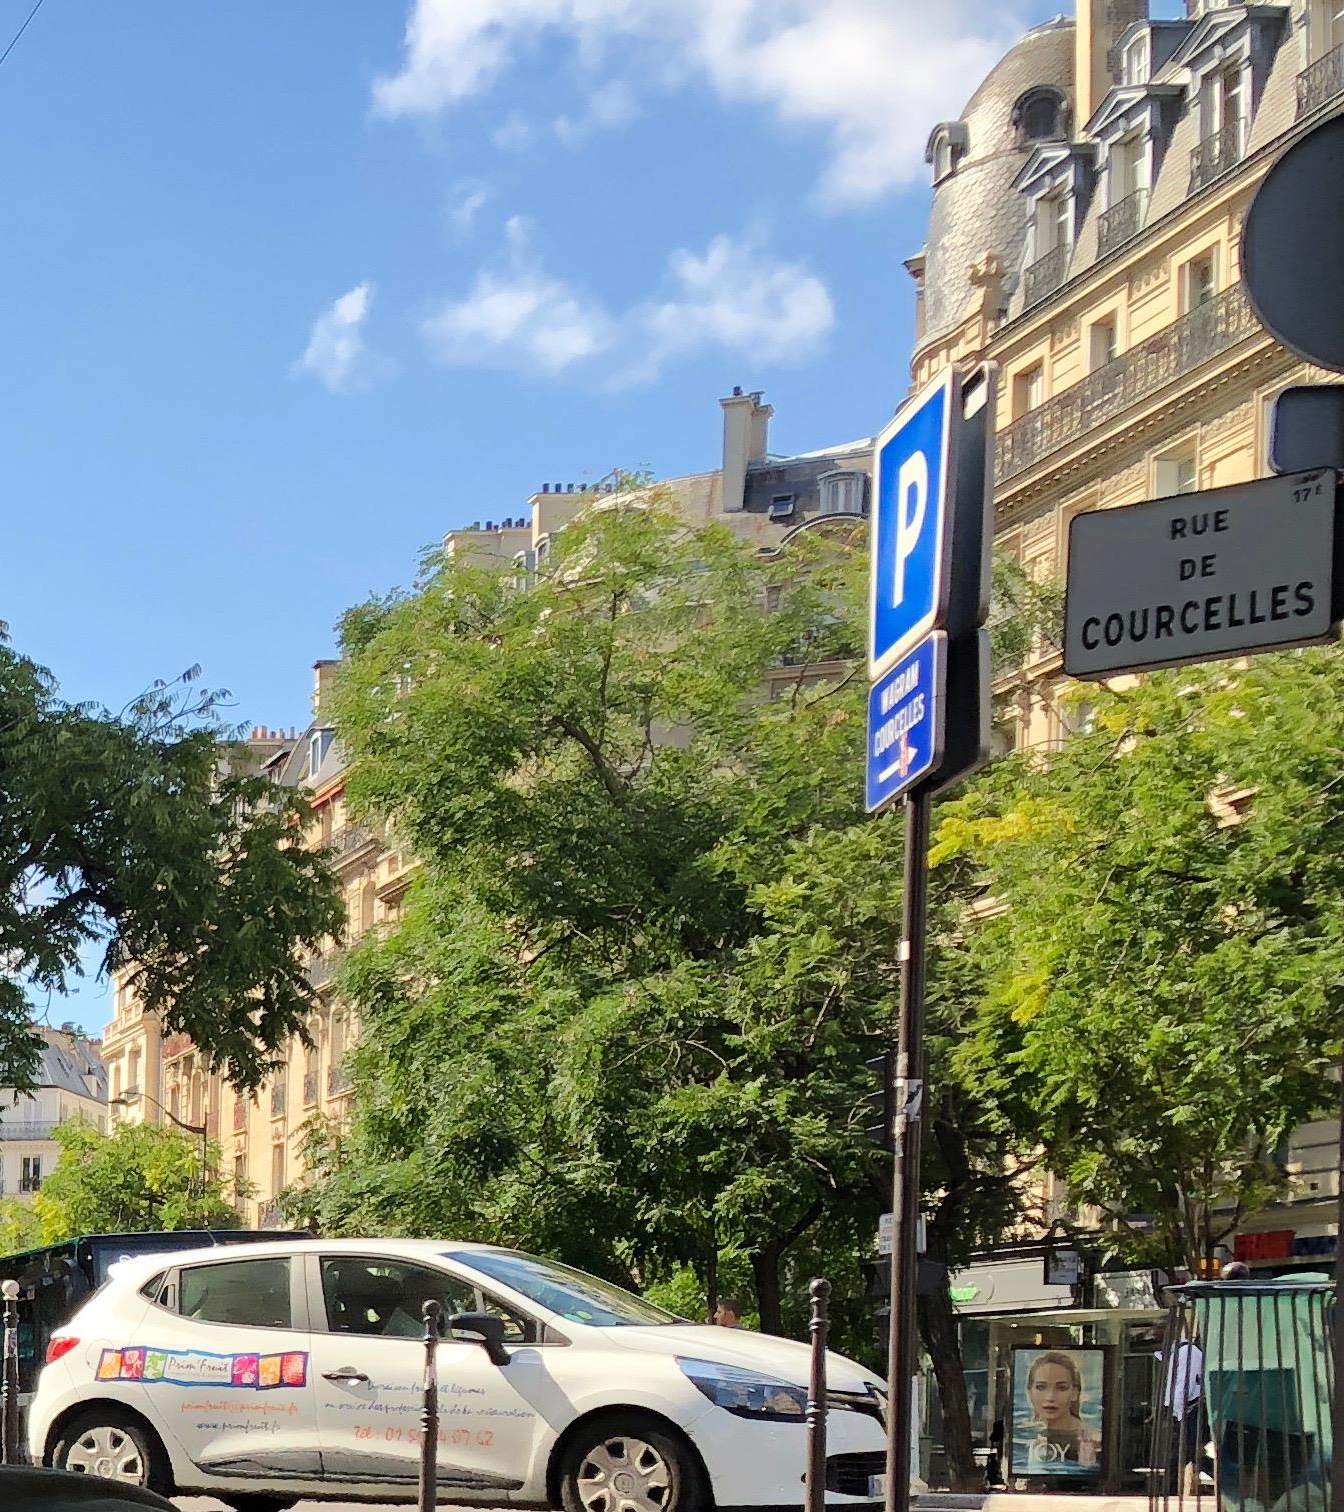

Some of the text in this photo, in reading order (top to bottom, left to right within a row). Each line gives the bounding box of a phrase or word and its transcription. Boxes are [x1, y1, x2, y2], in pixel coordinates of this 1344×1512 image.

[892, 449, 929, 609] P
[1170, 509, 1230, 541] RUE
[1179, 554, 1217, 581] DE
[1081, 581, 1315, 650] COURCELLES
